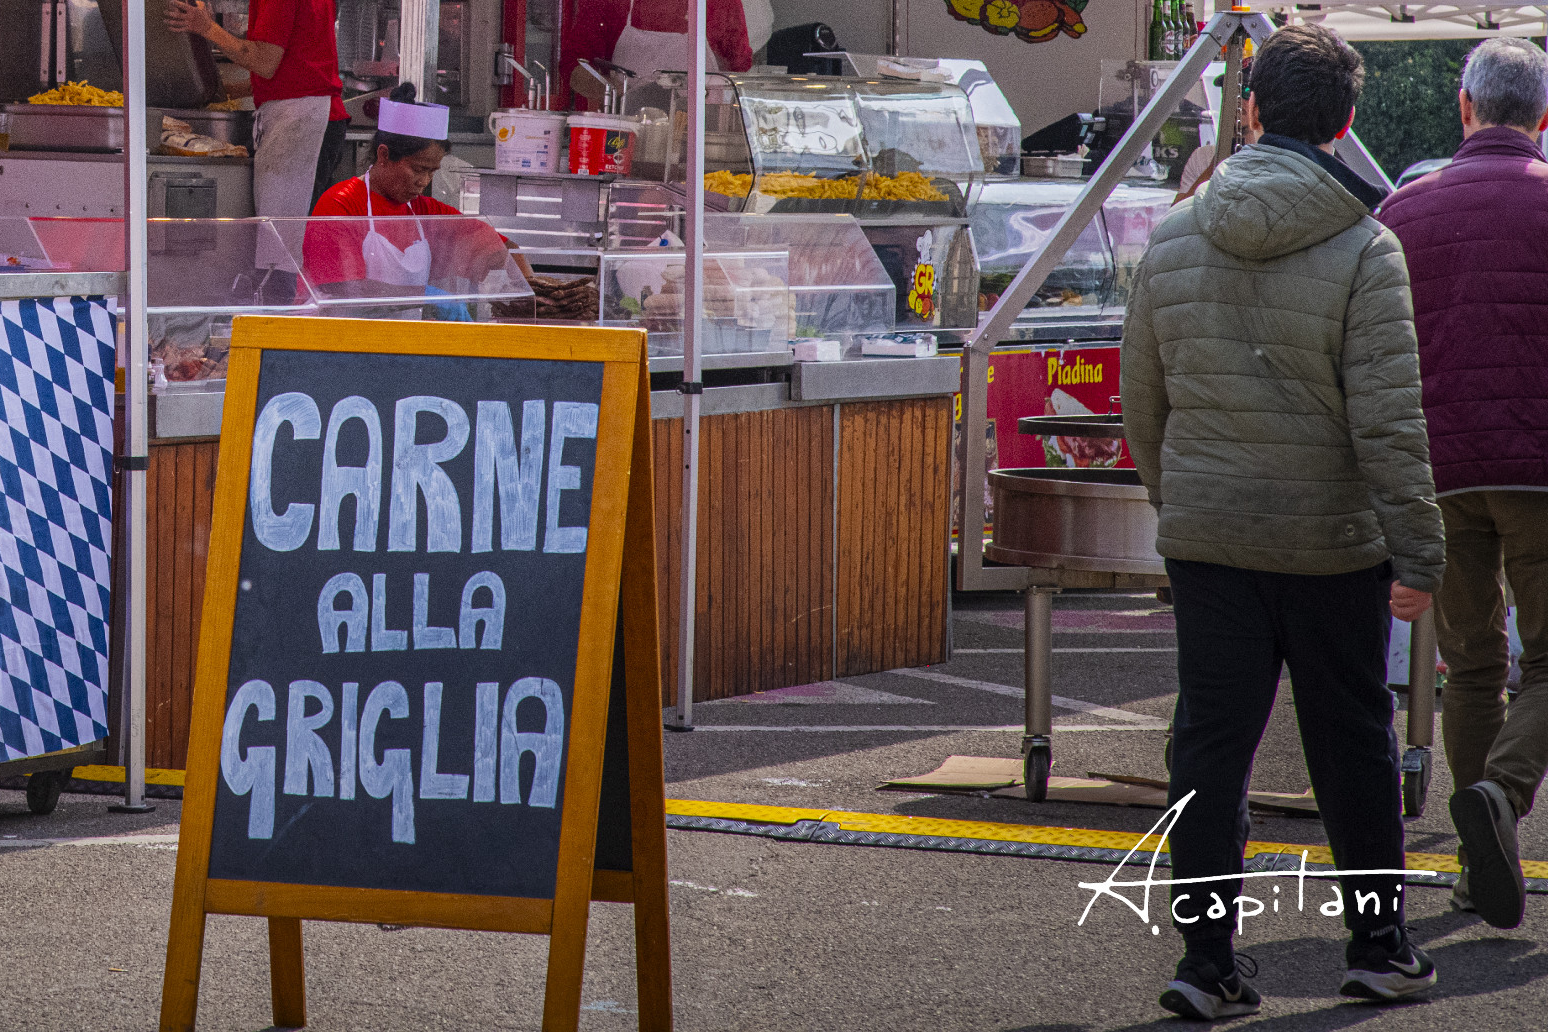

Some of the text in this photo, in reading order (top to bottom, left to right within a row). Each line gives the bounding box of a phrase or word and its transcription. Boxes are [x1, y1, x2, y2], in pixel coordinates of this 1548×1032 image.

[915, 264, 934, 295] GR
[1047, 355, 1103, 386] Piadina
[250, 391, 599, 555] CARNE
[317, 570, 507, 655] ALLA
[220, 676, 565, 845] GRIGLIA
